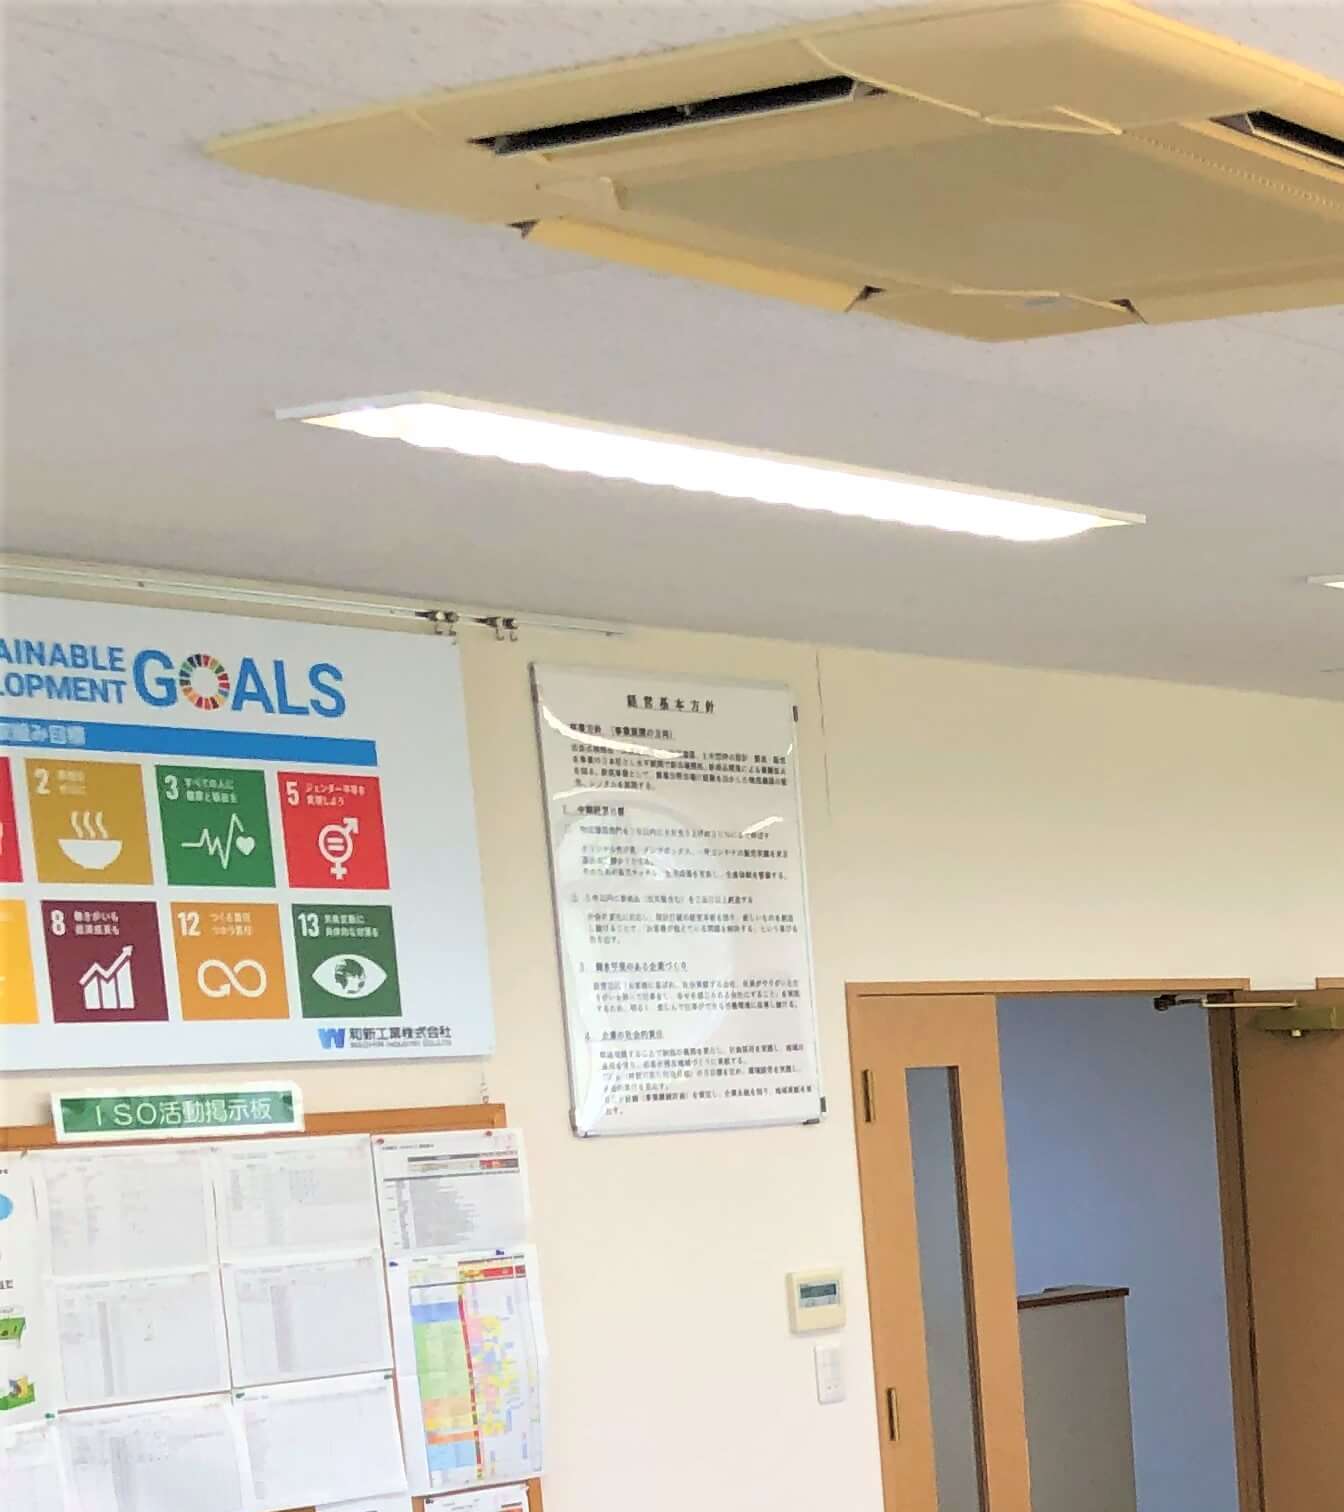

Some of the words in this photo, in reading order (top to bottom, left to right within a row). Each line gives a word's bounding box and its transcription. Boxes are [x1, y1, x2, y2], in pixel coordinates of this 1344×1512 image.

[0, 672, 127, 704] OPMENT
[132, 649, 347, 719] GOALS
[34, 768, 50, 795] 2
[164, 775, 179, 800] 3
[286, 781, 300, 806] 5
[51, 909, 66, 936] 8
[177, 911, 201, 937] 12
[298, 912, 320, 937] 13
